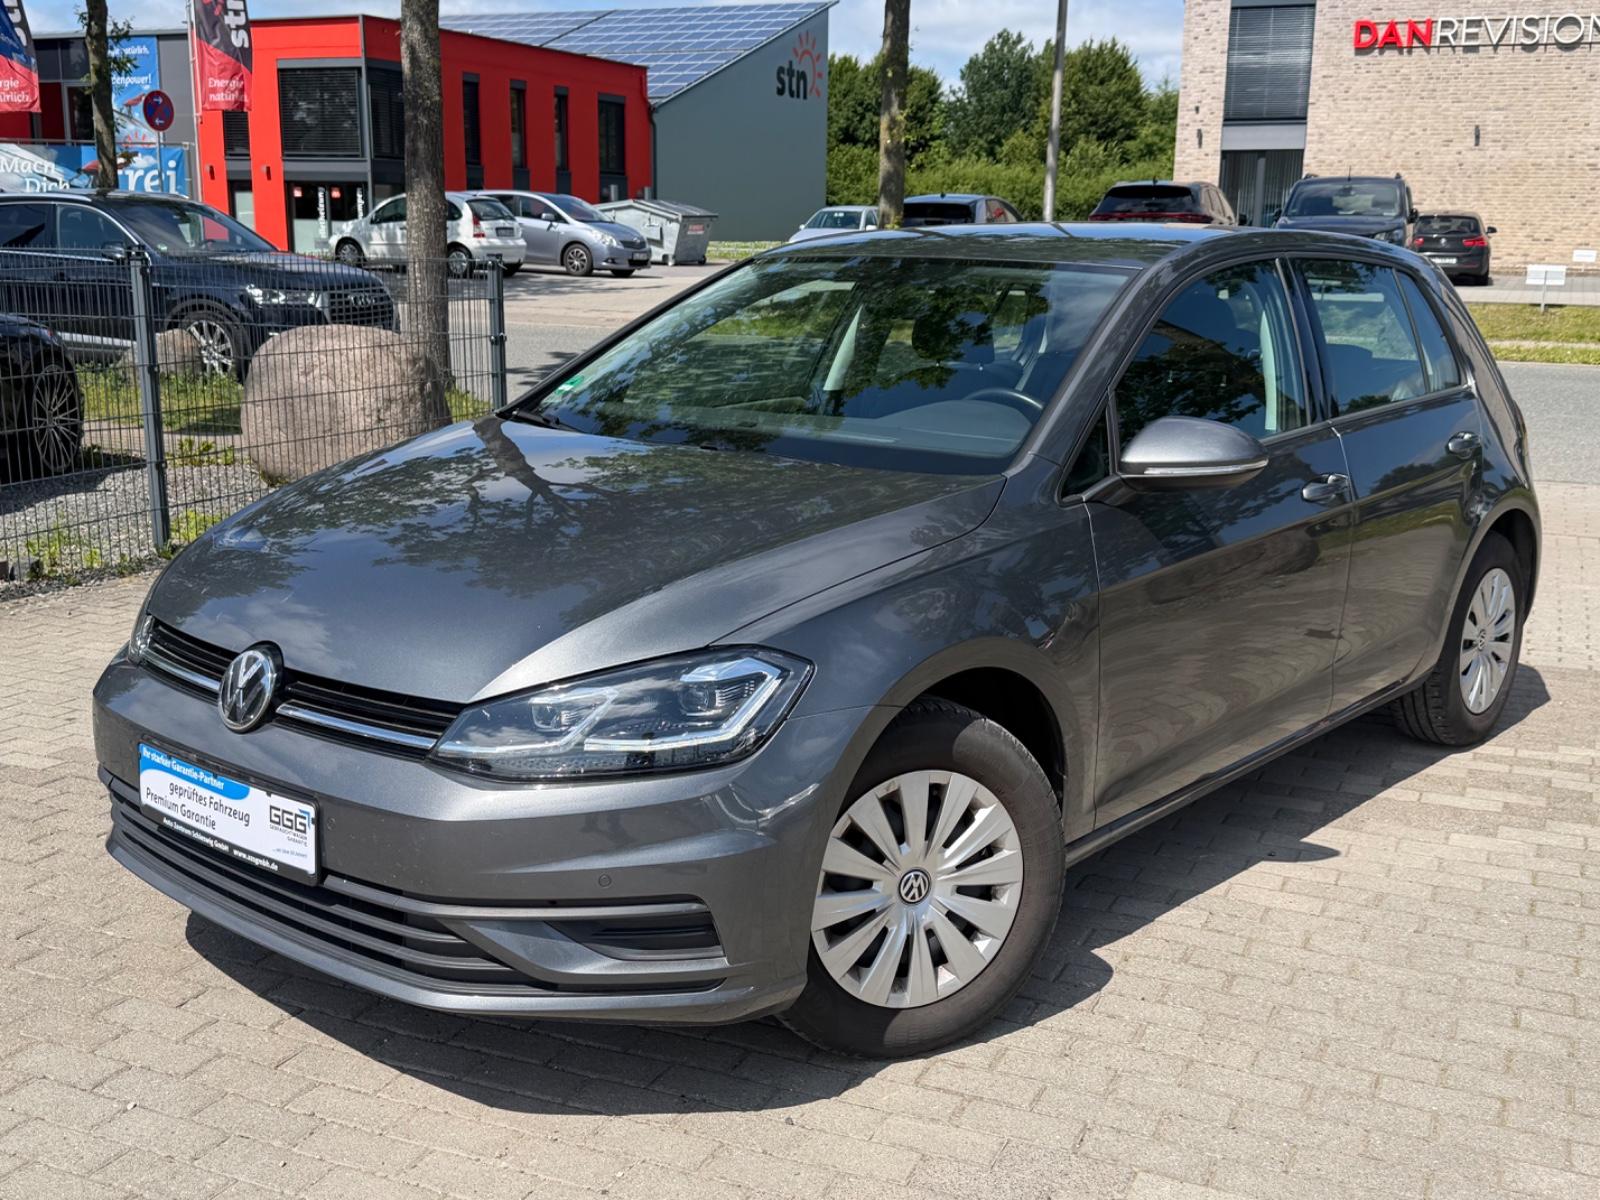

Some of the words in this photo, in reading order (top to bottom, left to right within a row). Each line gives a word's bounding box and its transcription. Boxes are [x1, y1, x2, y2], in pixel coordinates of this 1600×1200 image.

[776, 60, 807, 99] stn
[146, 787, 179, 813] Premium
[180, 803, 216, 830] Garantie
[169, 782, 207, 806] geprüftes
[209, 796, 250, 827] Fahrzeug
[270, 805, 307, 834] GGG
